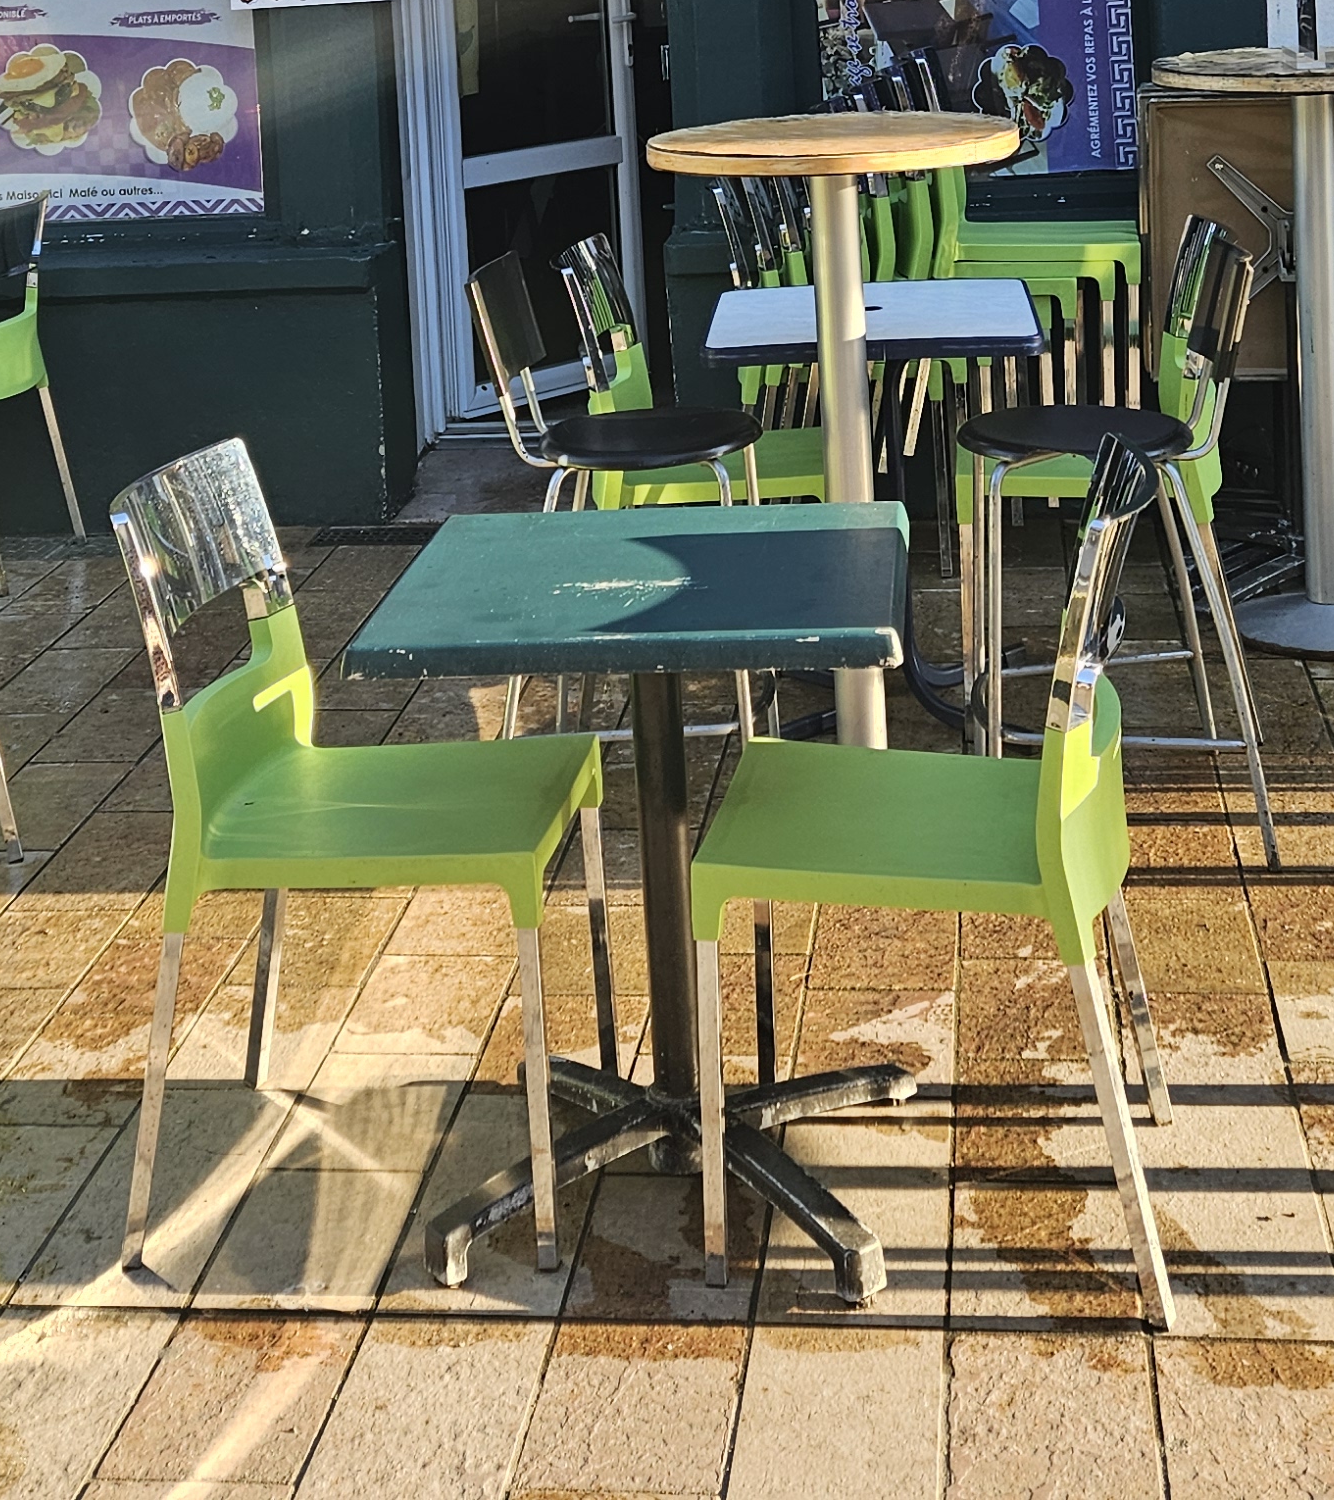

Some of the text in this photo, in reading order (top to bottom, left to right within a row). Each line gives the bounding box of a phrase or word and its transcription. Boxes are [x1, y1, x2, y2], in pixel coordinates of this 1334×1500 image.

[1079, 6, 1093, 16] À
[1084, 18, 1095, 54] REPAS
[1085, 56, 1097, 82] VOS
[1086, 83, 1102, 158] AGRÉMENTEZ
[6, 189, 39, 202] Maiso
[69, 186, 98, 199] Mafé
[101, 188, 115, 198] ou
[119, 186, 163, 196] autres...
